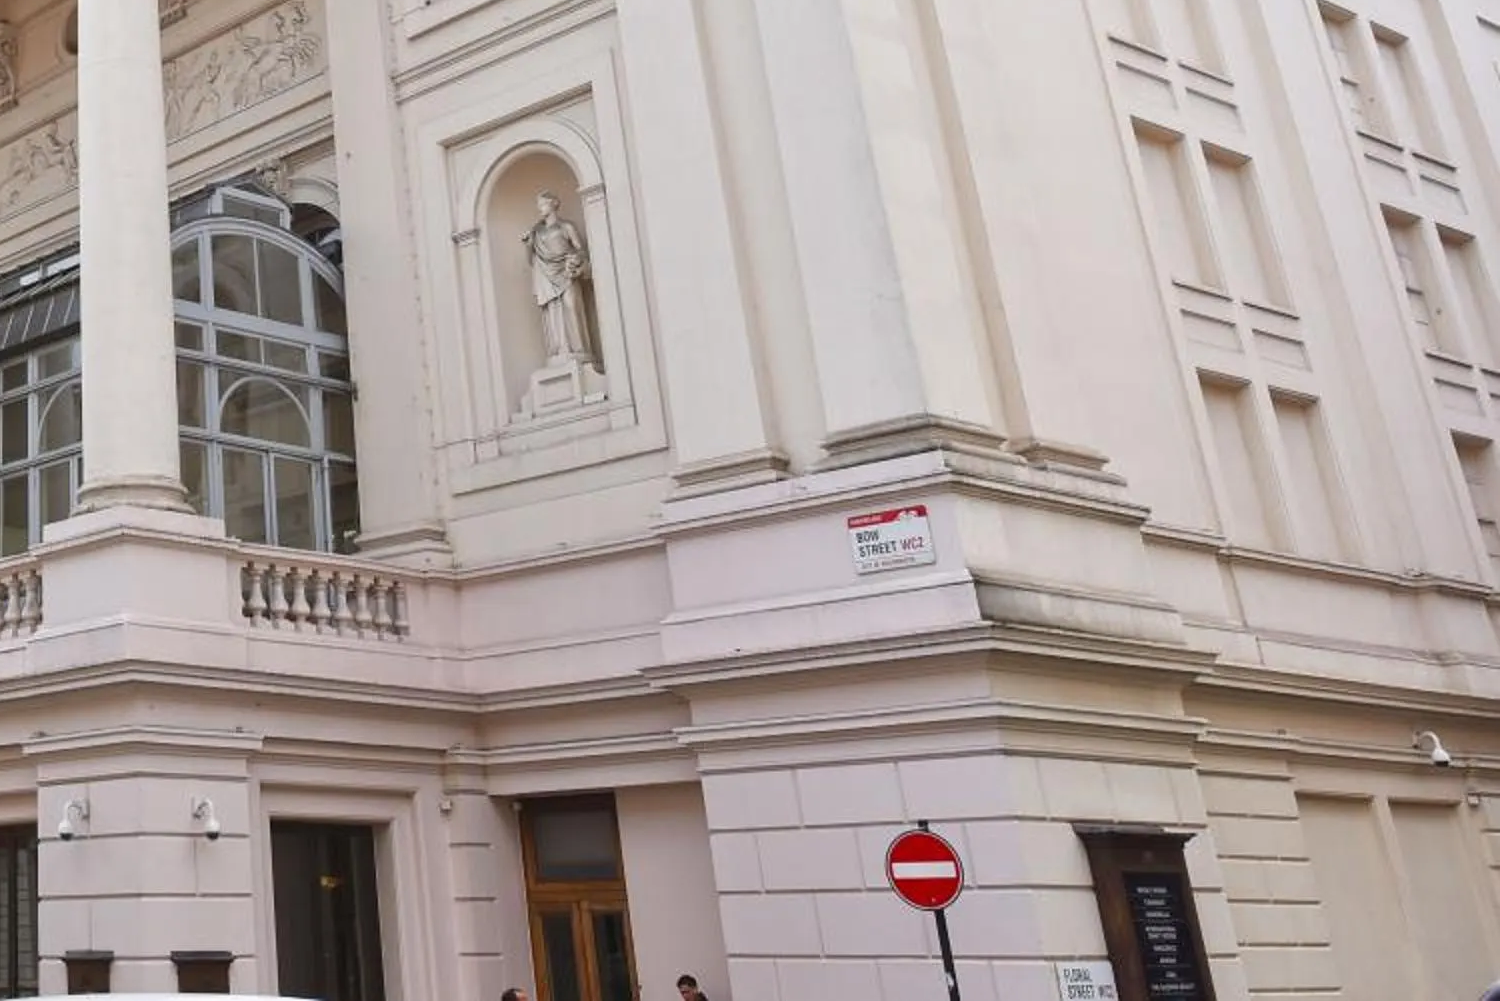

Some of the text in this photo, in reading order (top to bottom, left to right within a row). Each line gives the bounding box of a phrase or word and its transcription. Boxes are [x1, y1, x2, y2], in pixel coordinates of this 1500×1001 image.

[855, 529, 879, 544] BOW
[858, 536, 924, 558] STREET WC2
[1067, 984, 1096, 999] STREET
